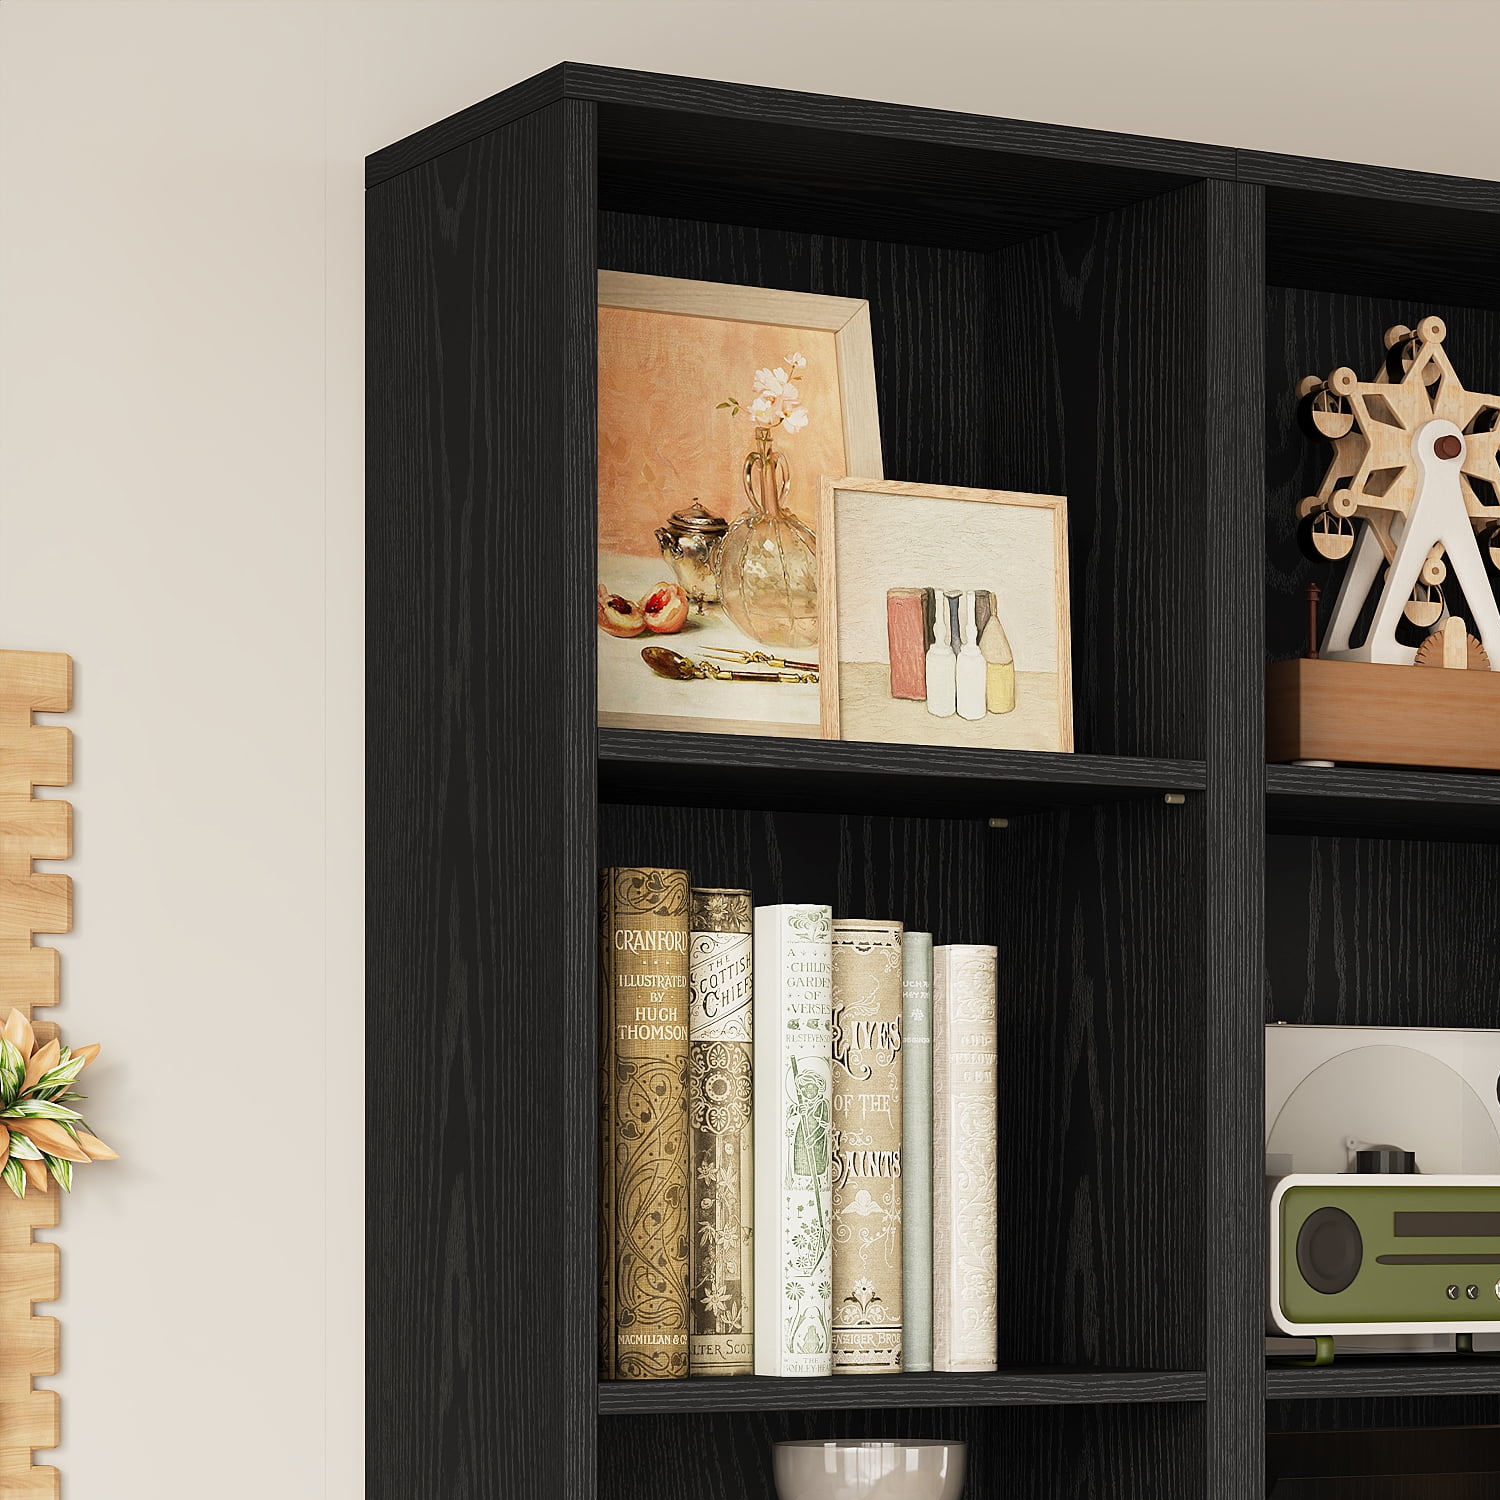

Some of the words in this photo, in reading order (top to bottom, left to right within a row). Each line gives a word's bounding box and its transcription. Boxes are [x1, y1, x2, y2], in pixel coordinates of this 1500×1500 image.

[615, 929, 688, 955] CRANFORD
[787, 948, 796, 958] A
[708, 954, 731, 971] THE
[619, 974, 687, 990] ILLUSTRATED
[649, 991, 666, 1003] BY
[804, 990, 822, 1001] OF
[635, 1007, 678, 1022] HUGH
[791, 1003, 831, 1015] VERSES
[617, 1024, 688, 1041] THOMSON
[834, 1093, 854, 1120] OF
[618, 1333, 671, 1346] MACMILLAN
